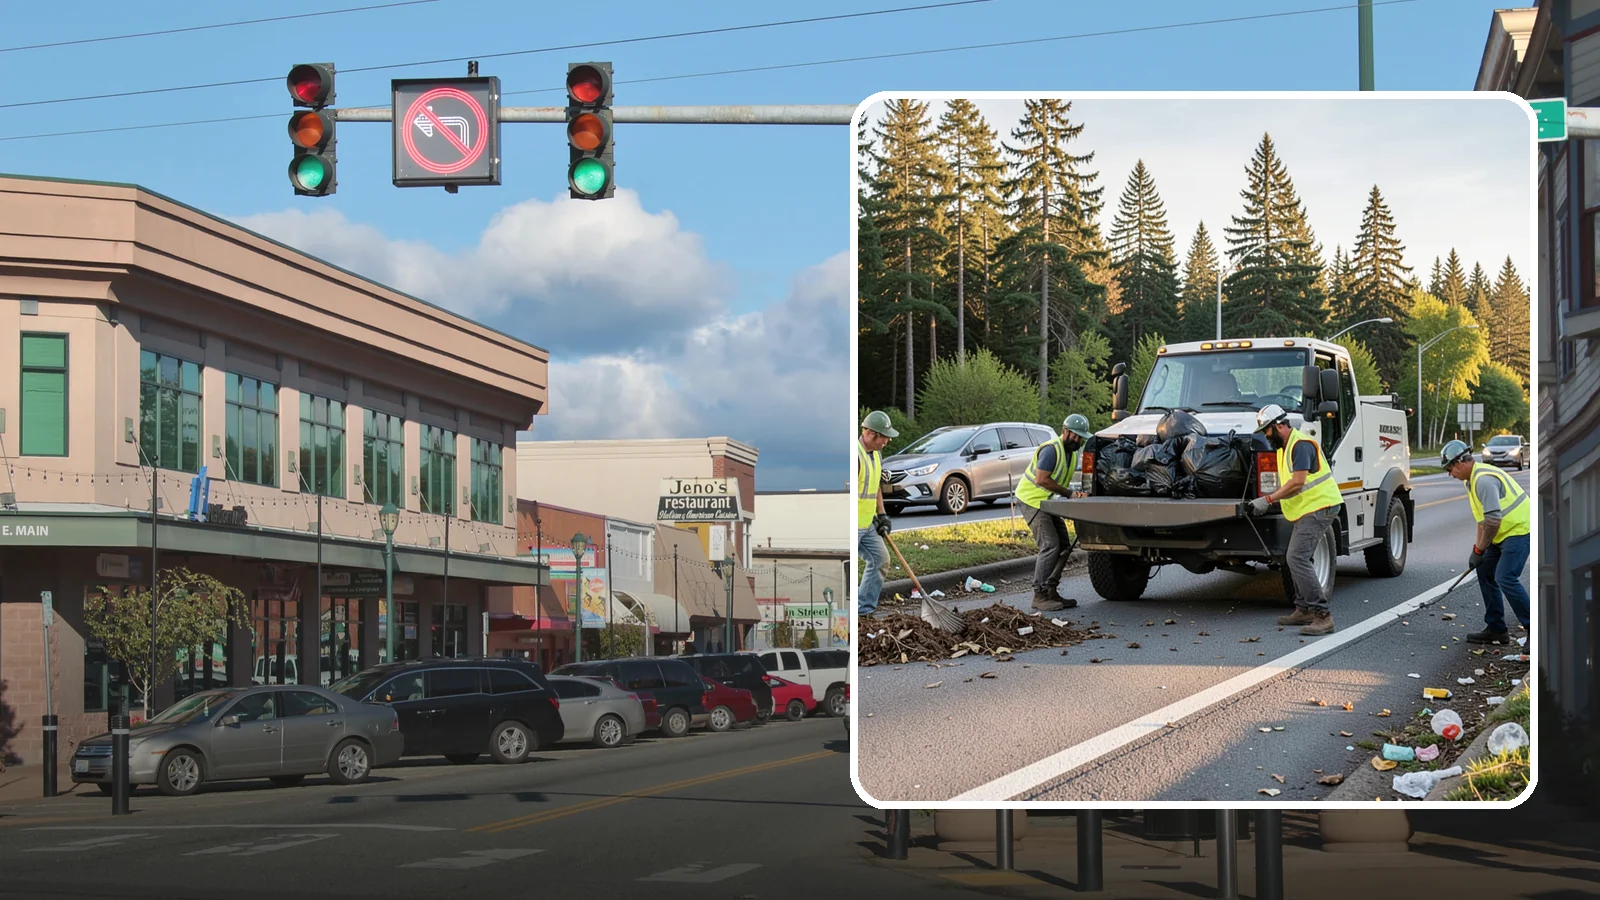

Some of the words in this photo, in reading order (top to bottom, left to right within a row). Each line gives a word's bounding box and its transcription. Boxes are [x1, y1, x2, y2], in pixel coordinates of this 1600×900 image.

[669, 480, 727, 495] Jeno's
[665, 496, 731, 509] restaurant
[715, 509, 738, 519] Cuisine
[2, 525, 13, 536] E.
[15, 525, 49, 536] MAIN
[797, 608, 828, 616] Street
